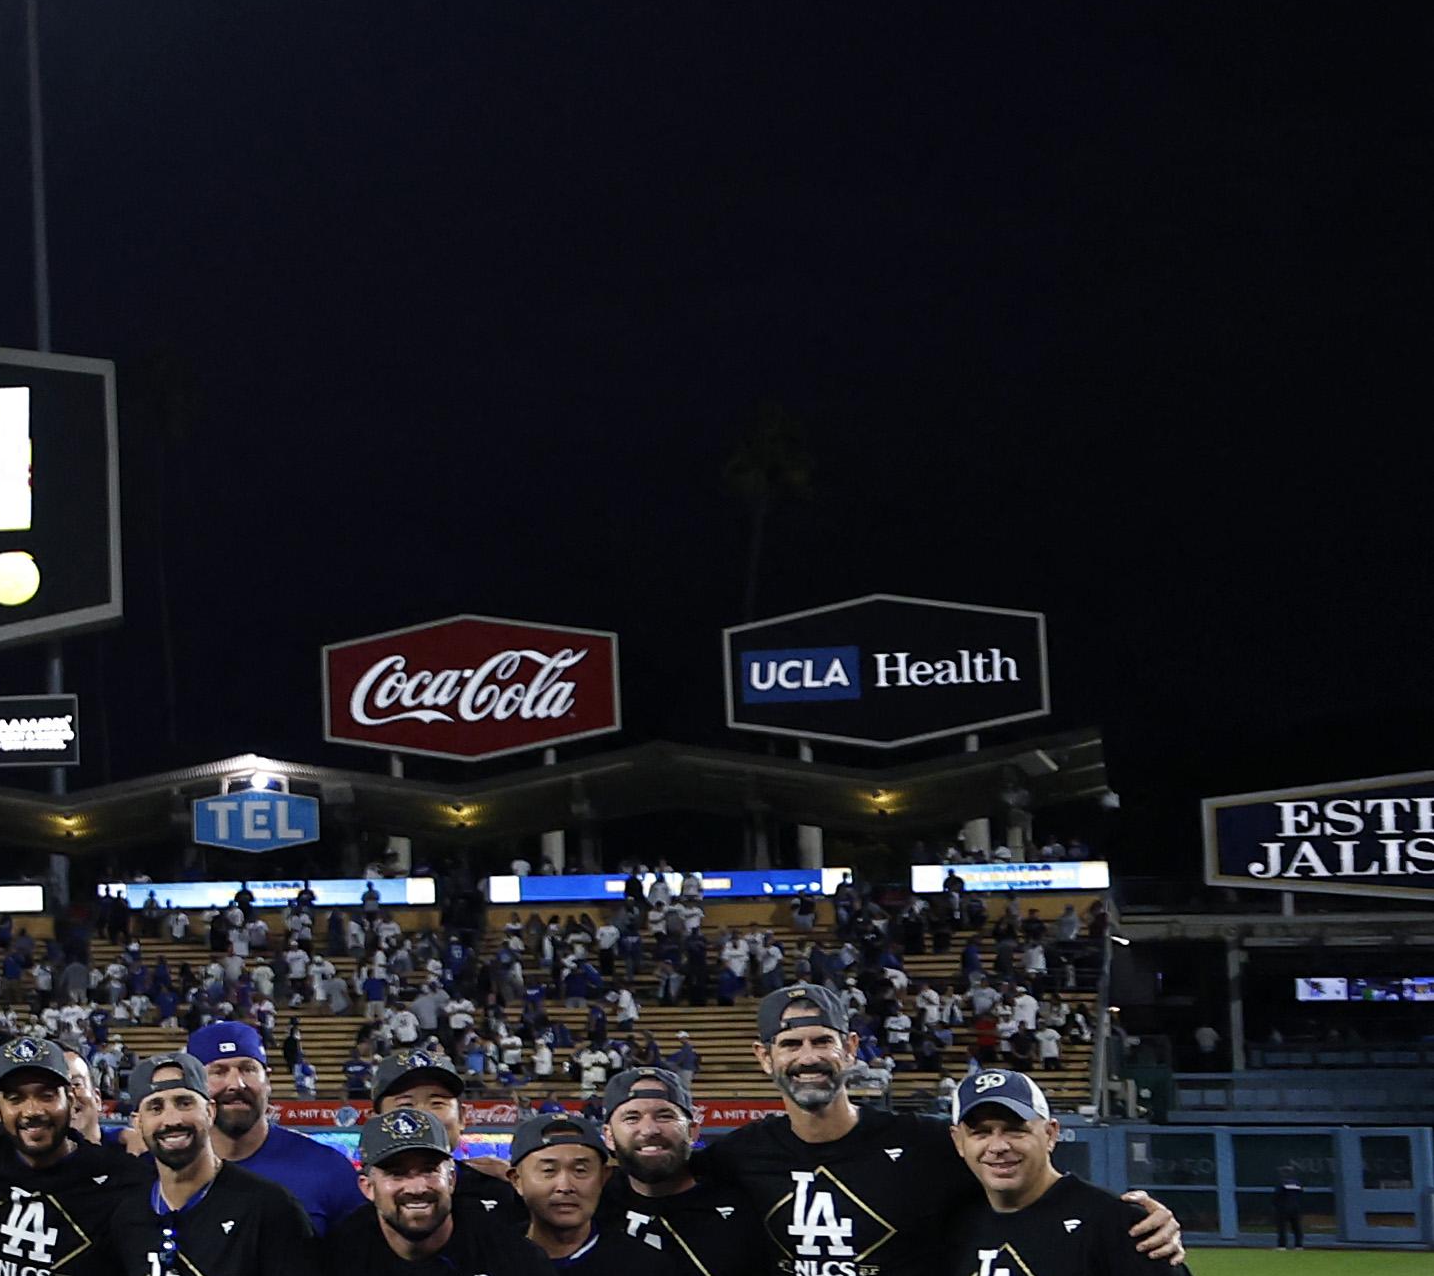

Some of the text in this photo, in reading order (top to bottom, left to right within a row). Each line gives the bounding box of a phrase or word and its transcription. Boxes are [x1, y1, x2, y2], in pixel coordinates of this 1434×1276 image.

[351, 649, 587, 725] Coca-Cola
[751, 649, 1019, 690] UCLA Health
[207, 800, 304, 839] TEL
[727, 1111, 748, 1119] HIT
[0, 1187, 59, 1264] LA
[787, 1170, 853, 1255] LA
